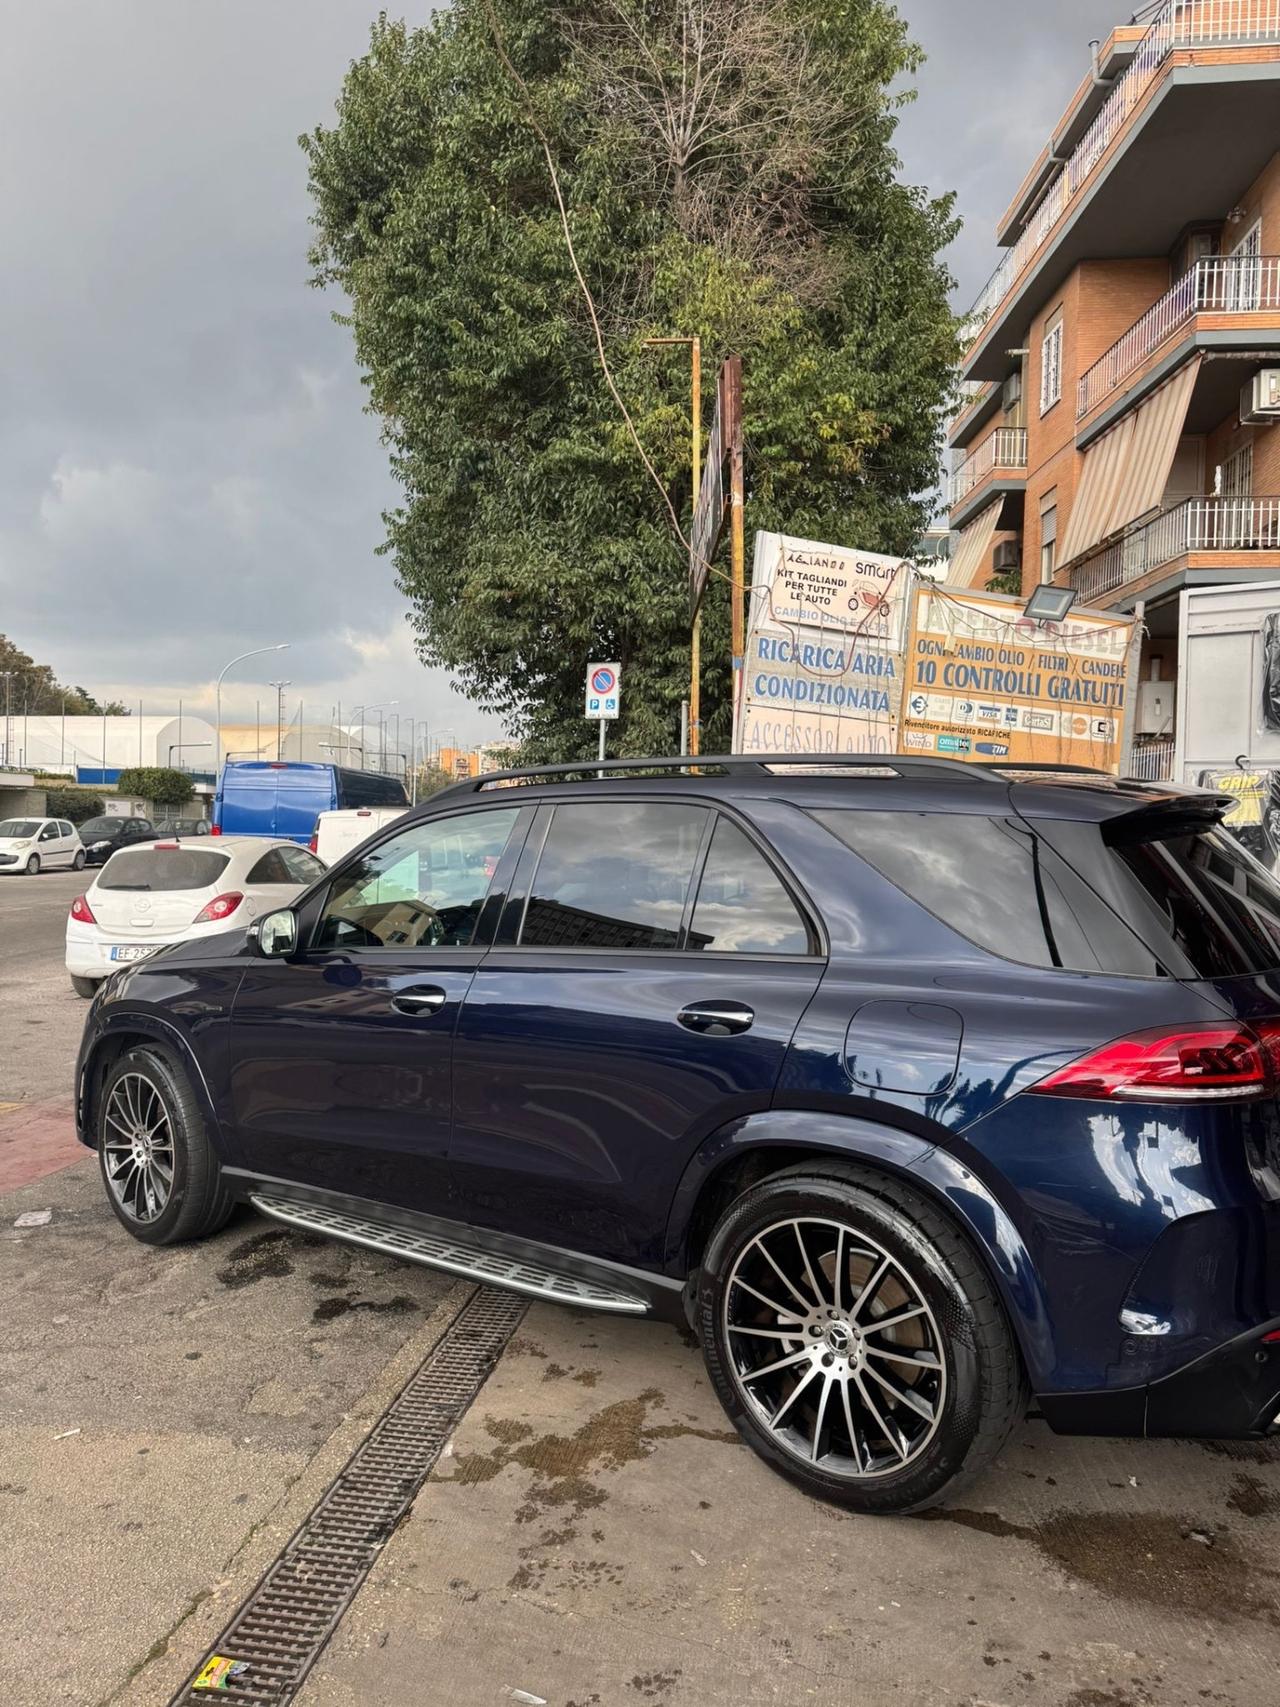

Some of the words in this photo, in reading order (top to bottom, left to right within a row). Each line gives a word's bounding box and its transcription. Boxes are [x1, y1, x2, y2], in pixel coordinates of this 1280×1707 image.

[777, 568, 794, 579] KIT
[796, 571, 847, 588] TAGLIANDI
[855, 561, 896, 580] smart
[785, 580, 804, 591] PER
[806, 584, 838, 596] TUTTE
[790, 591, 802, 601] LE
[804, 594, 831, 606] AUTO
[774, 606, 819, 621] CAMBIO
[758, 637, 845, 673] RICARICA
[851, 652, 895, 678] ARIA
[998, 648, 1025, 666] OLIO
[1038, 654, 1069, 673] FILTRI
[1081, 660, 1127, 679] CANDELE
[917, 660, 937, 684] 10
[943, 663, 1041, 697] CONTROLLI
[1047, 675, 1124, 707] GRATUITI
[754, 674, 890, 712] CONDIZIONATA
[982, 709, 998, 719] VISA
[904, 718, 940, 731] Rivenditore
[941, 724, 976, 735] autorizzato
[906, 739, 931, 748] WIND
[992, 745, 1007, 755] TIM
[1218, 775, 1260, 790] GRIP
